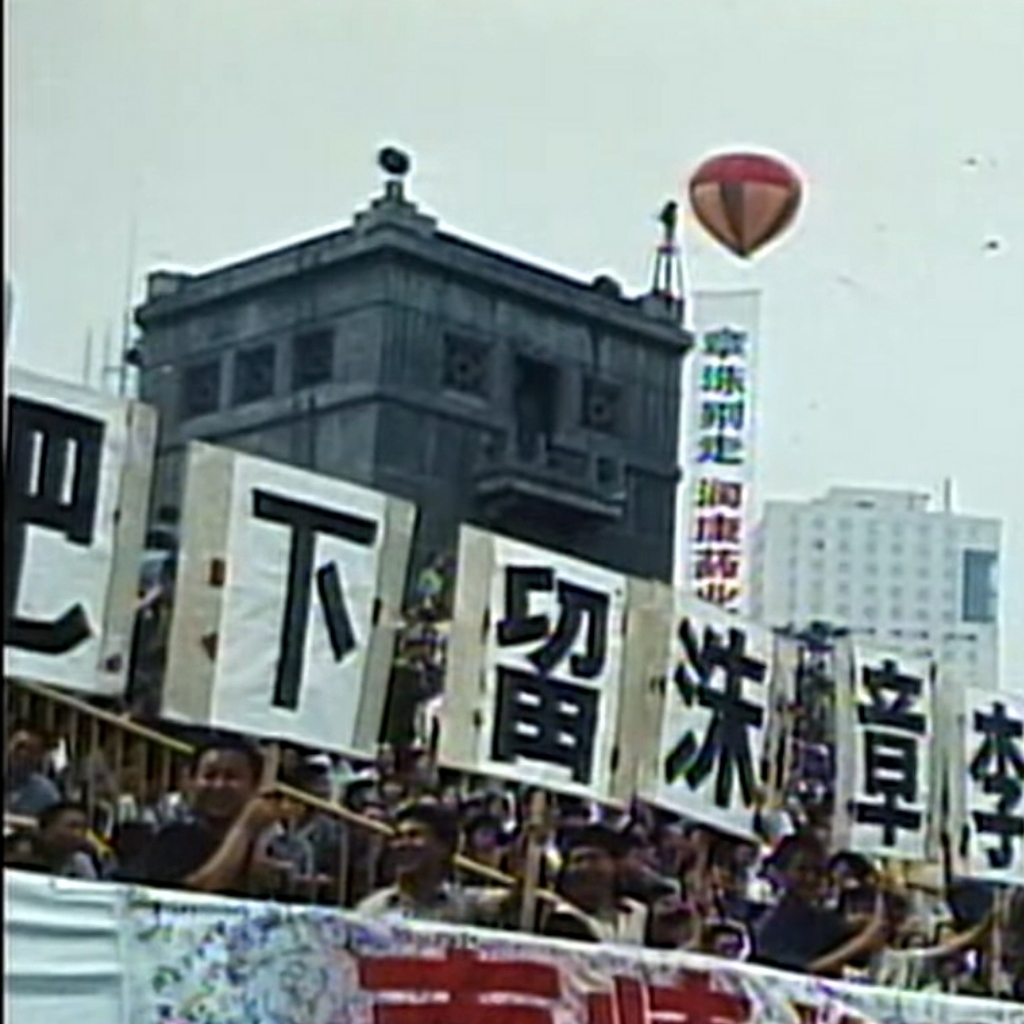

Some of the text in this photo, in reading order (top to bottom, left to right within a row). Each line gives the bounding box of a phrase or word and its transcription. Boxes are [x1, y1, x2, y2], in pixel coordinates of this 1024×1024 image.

[251, 486, 379, 712] 下
[494, 564, 611, 786] 留
[852, 659, 927, 846] 章
